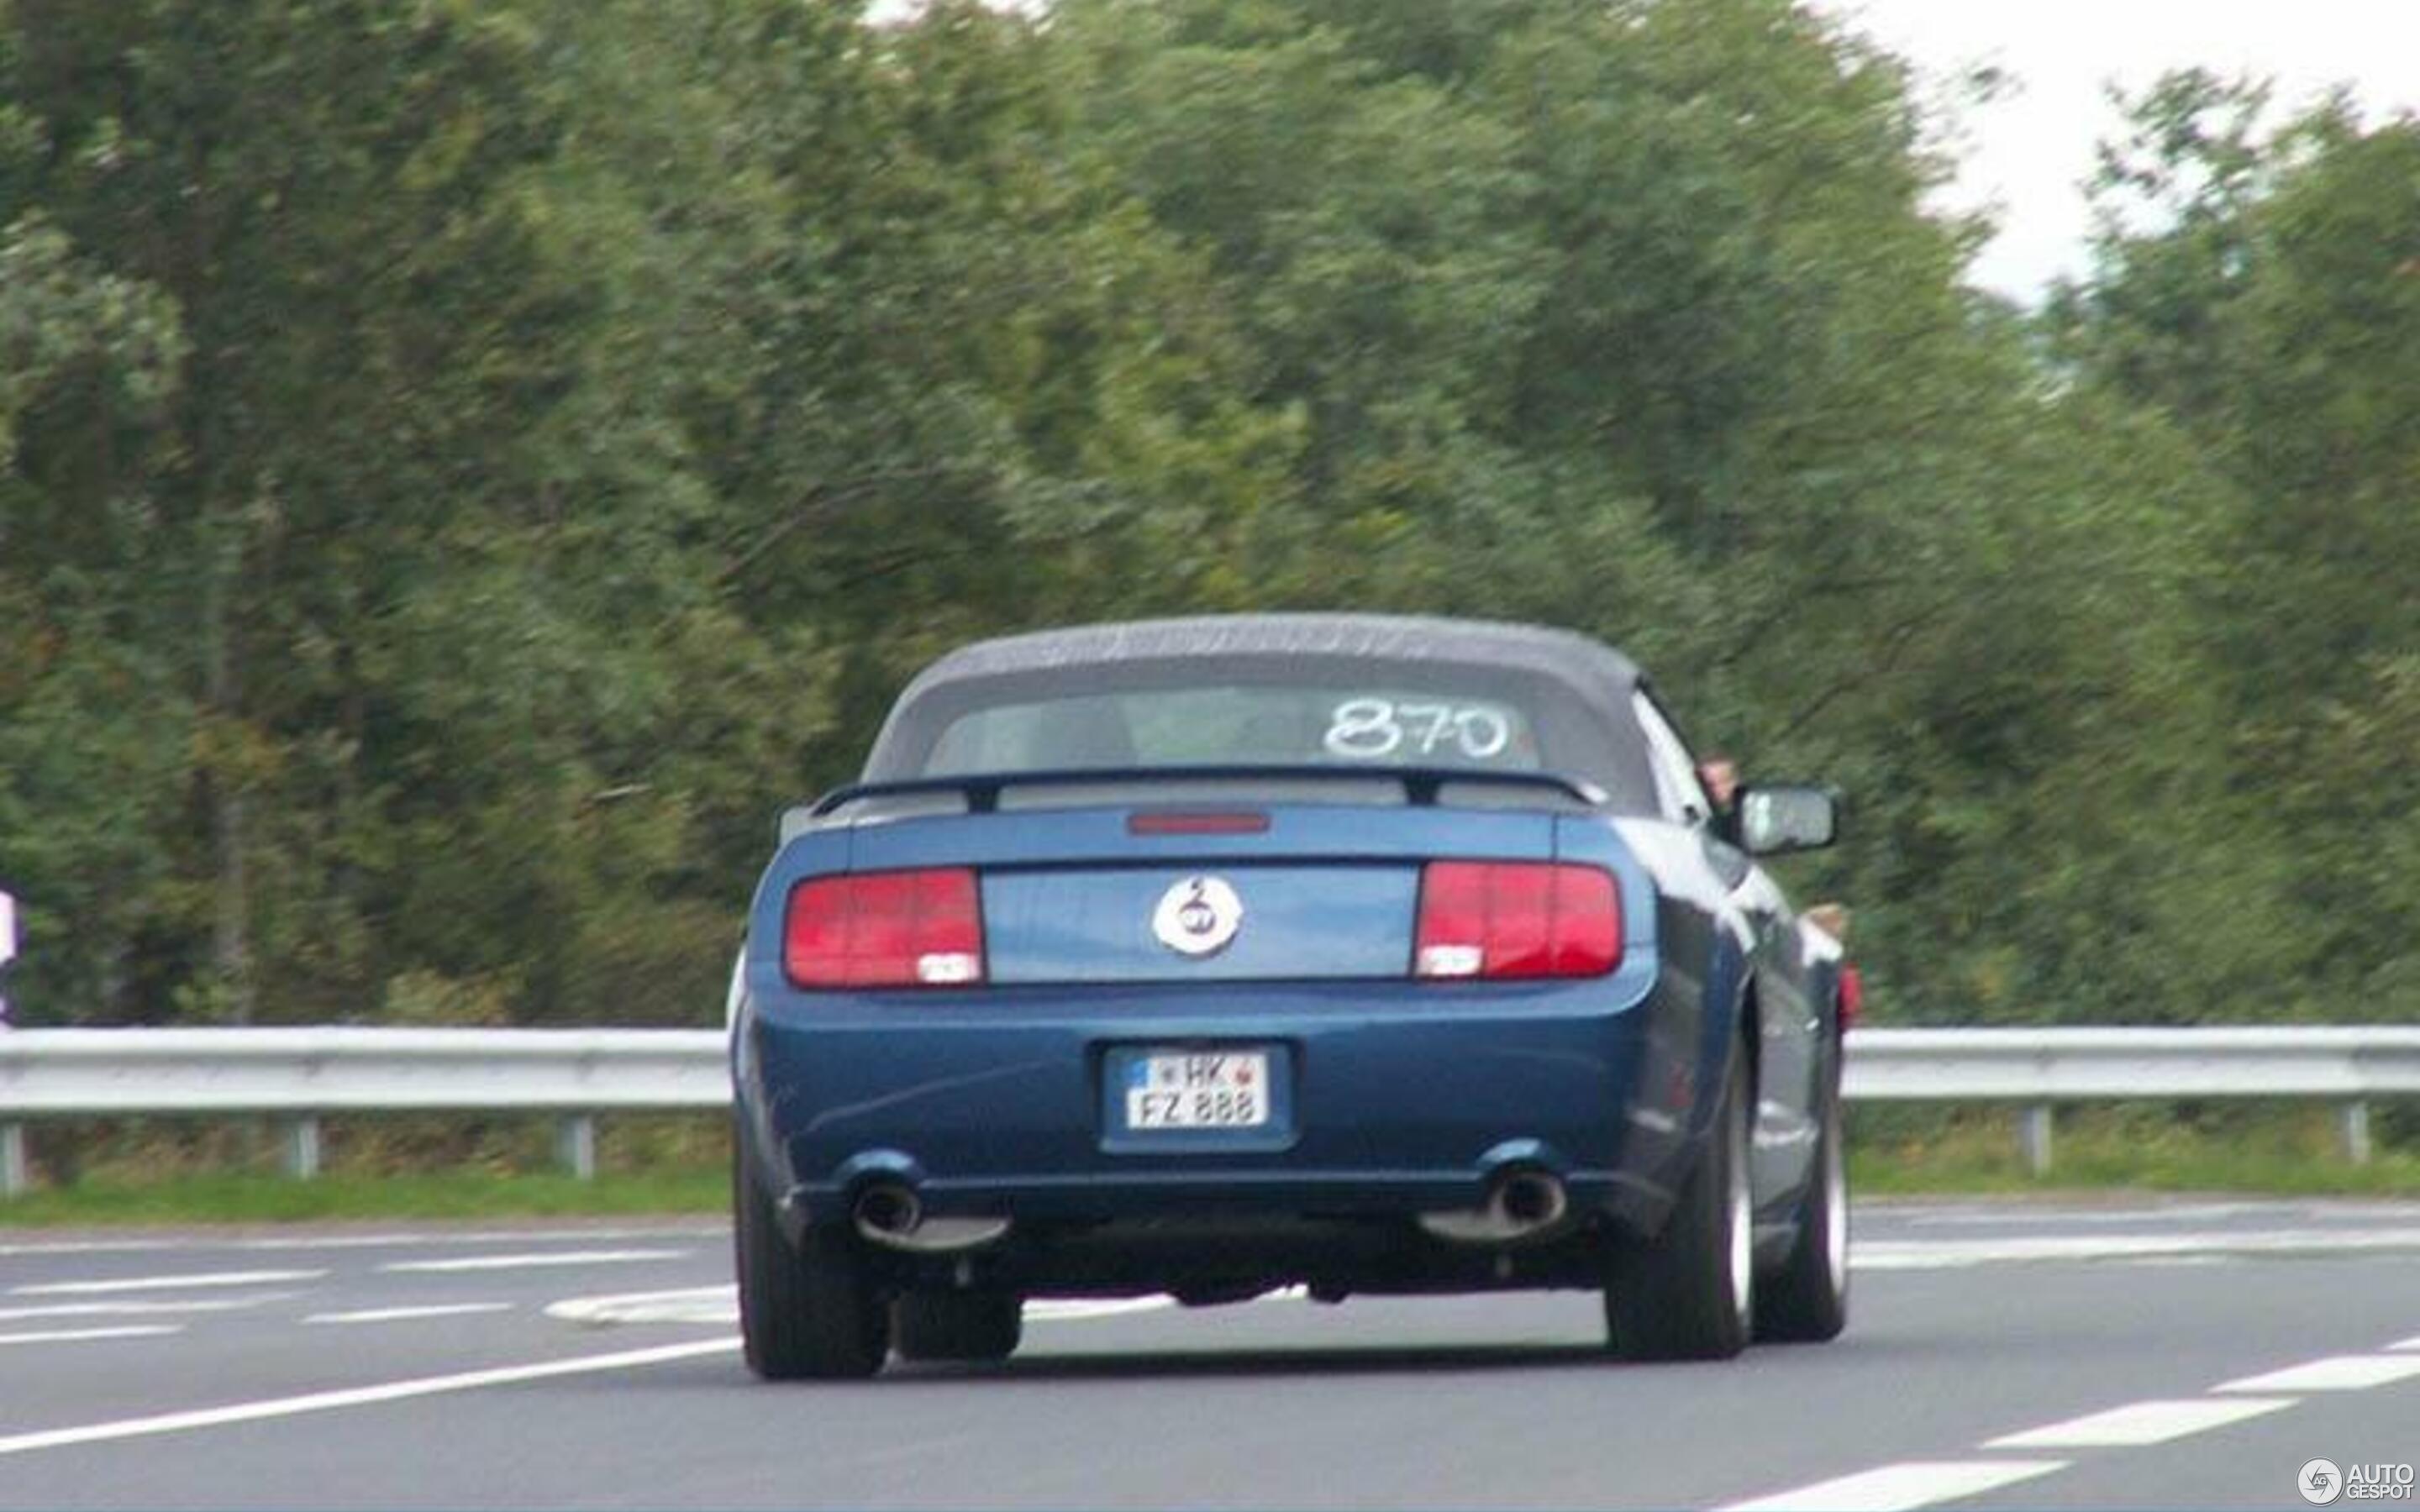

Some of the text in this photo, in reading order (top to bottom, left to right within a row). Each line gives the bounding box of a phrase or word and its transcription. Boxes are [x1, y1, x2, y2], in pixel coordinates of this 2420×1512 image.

[1324, 697, 1508, 758] 870
[1185, 1055, 1225, 1084] HK
[1140, 1092, 1254, 1123] FZ 888
